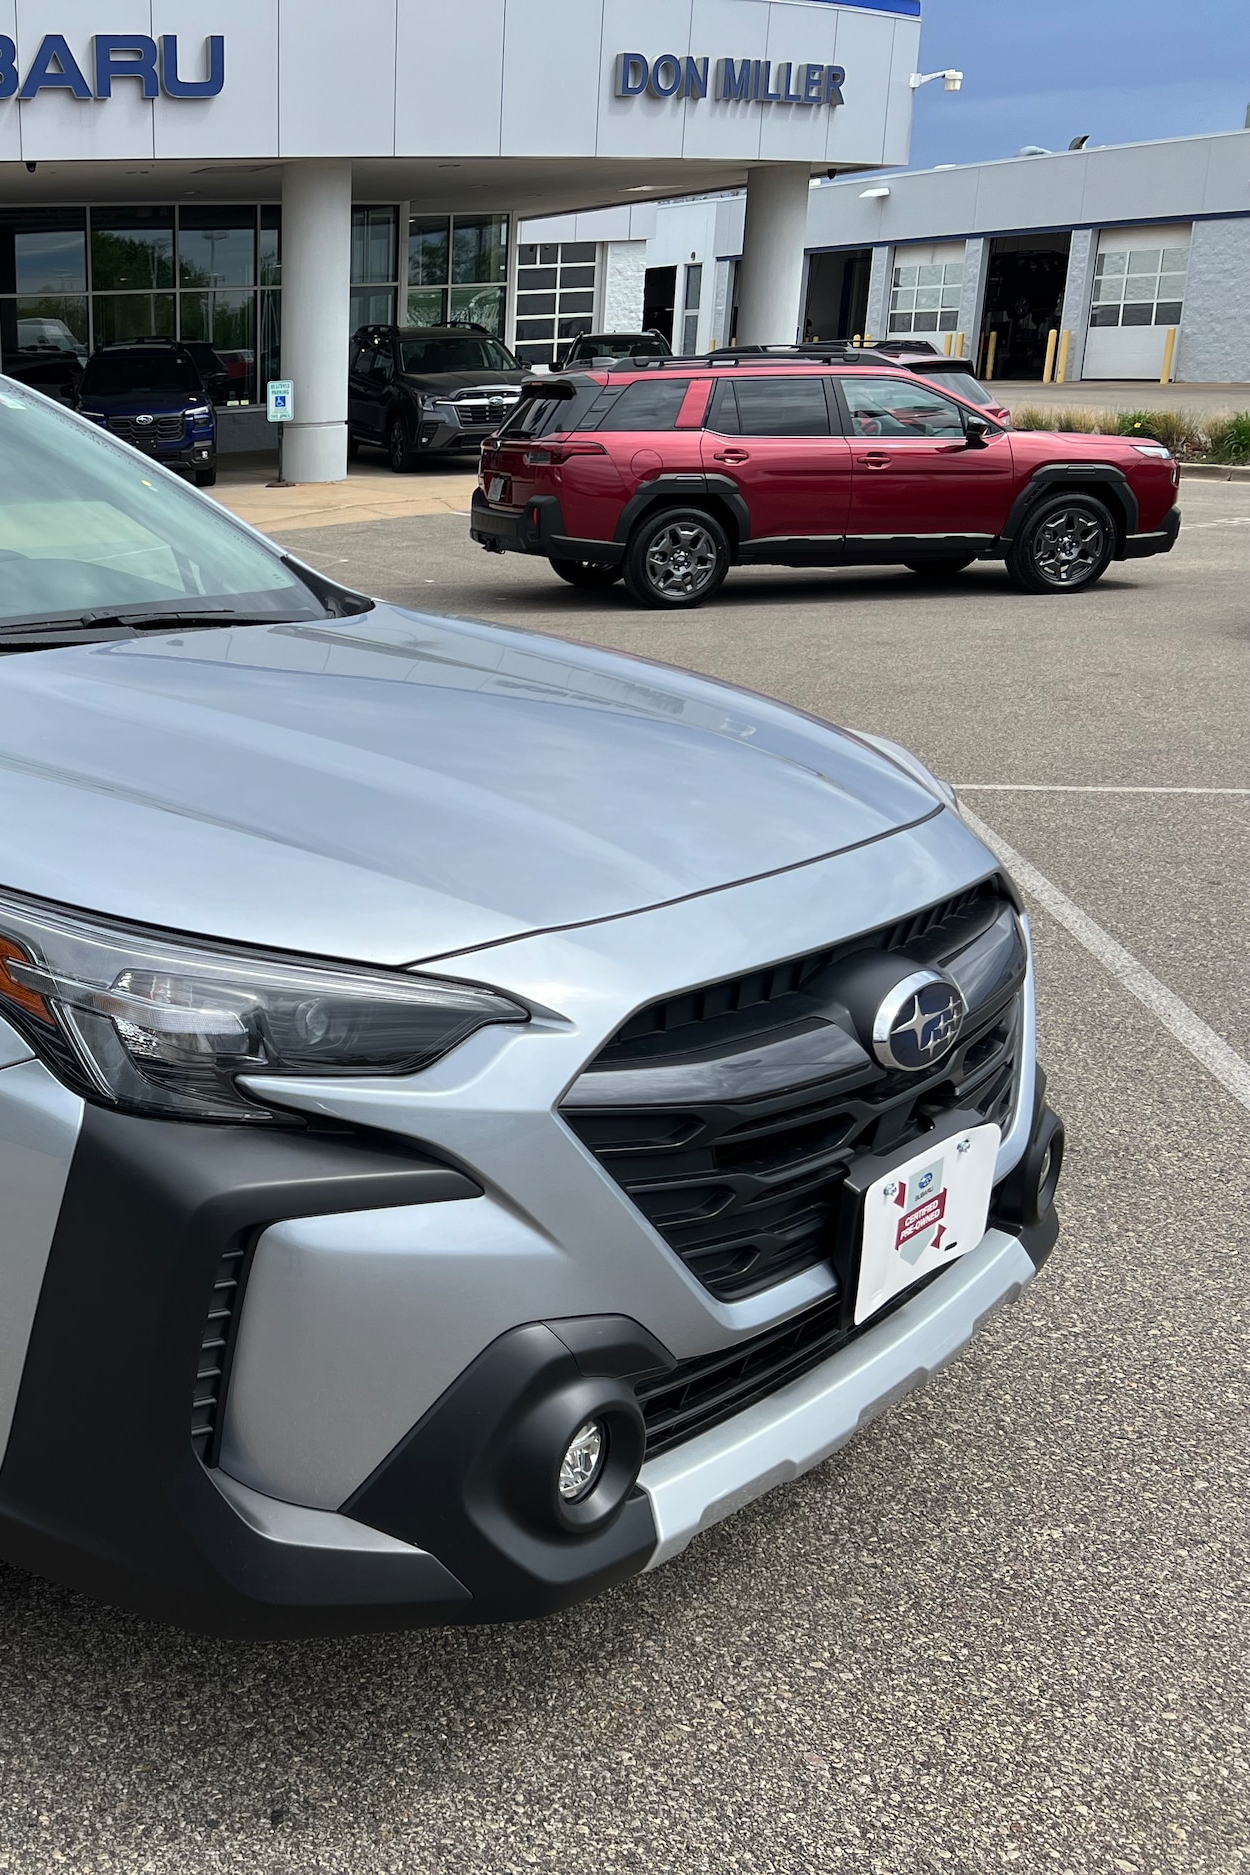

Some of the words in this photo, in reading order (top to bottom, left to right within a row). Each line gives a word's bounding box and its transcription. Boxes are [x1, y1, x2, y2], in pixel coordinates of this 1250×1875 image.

[616, 52, 709, 98] DON
[716, 57, 846, 106] MILLER
[900, 1208, 941, 1241] PRE-OWNED
[904, 1199, 939, 1227] CERTIFIED
